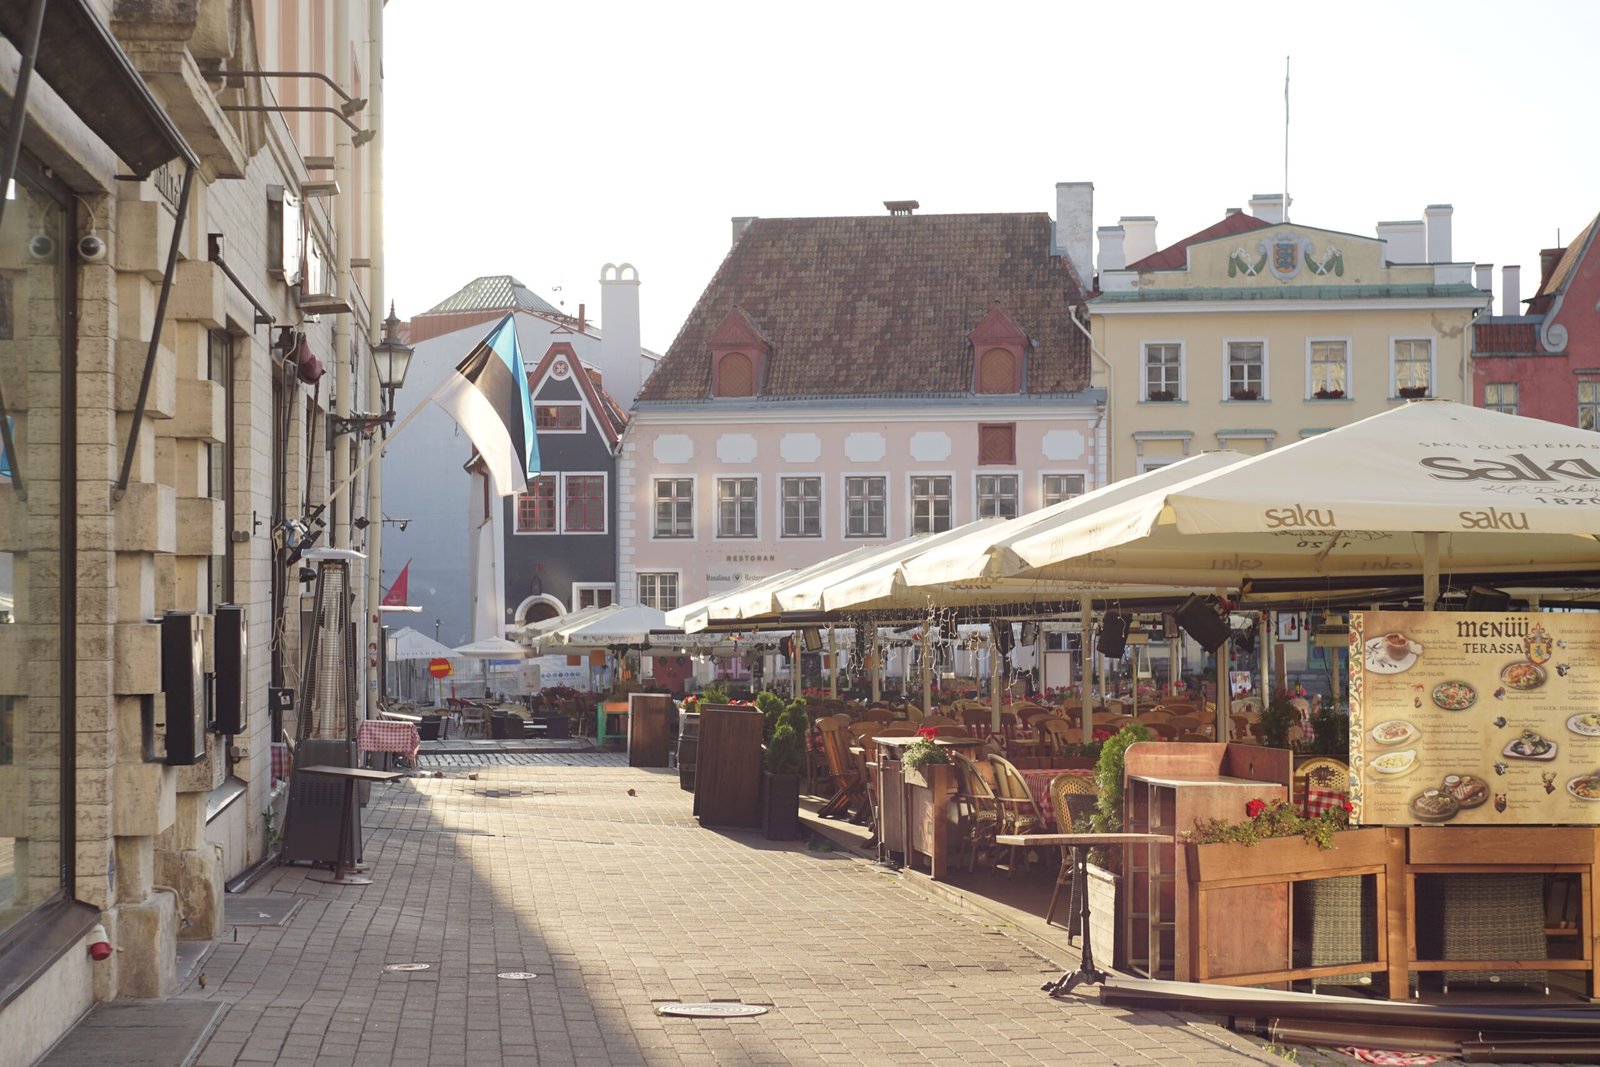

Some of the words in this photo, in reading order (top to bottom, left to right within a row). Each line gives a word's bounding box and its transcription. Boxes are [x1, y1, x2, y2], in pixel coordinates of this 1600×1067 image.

[1419, 453, 1600, 482] sak
[1264, 503, 1336, 528] saku
[1459, 507, 1530, 530] saku
[1464, 643, 1524, 654] TERASSA
